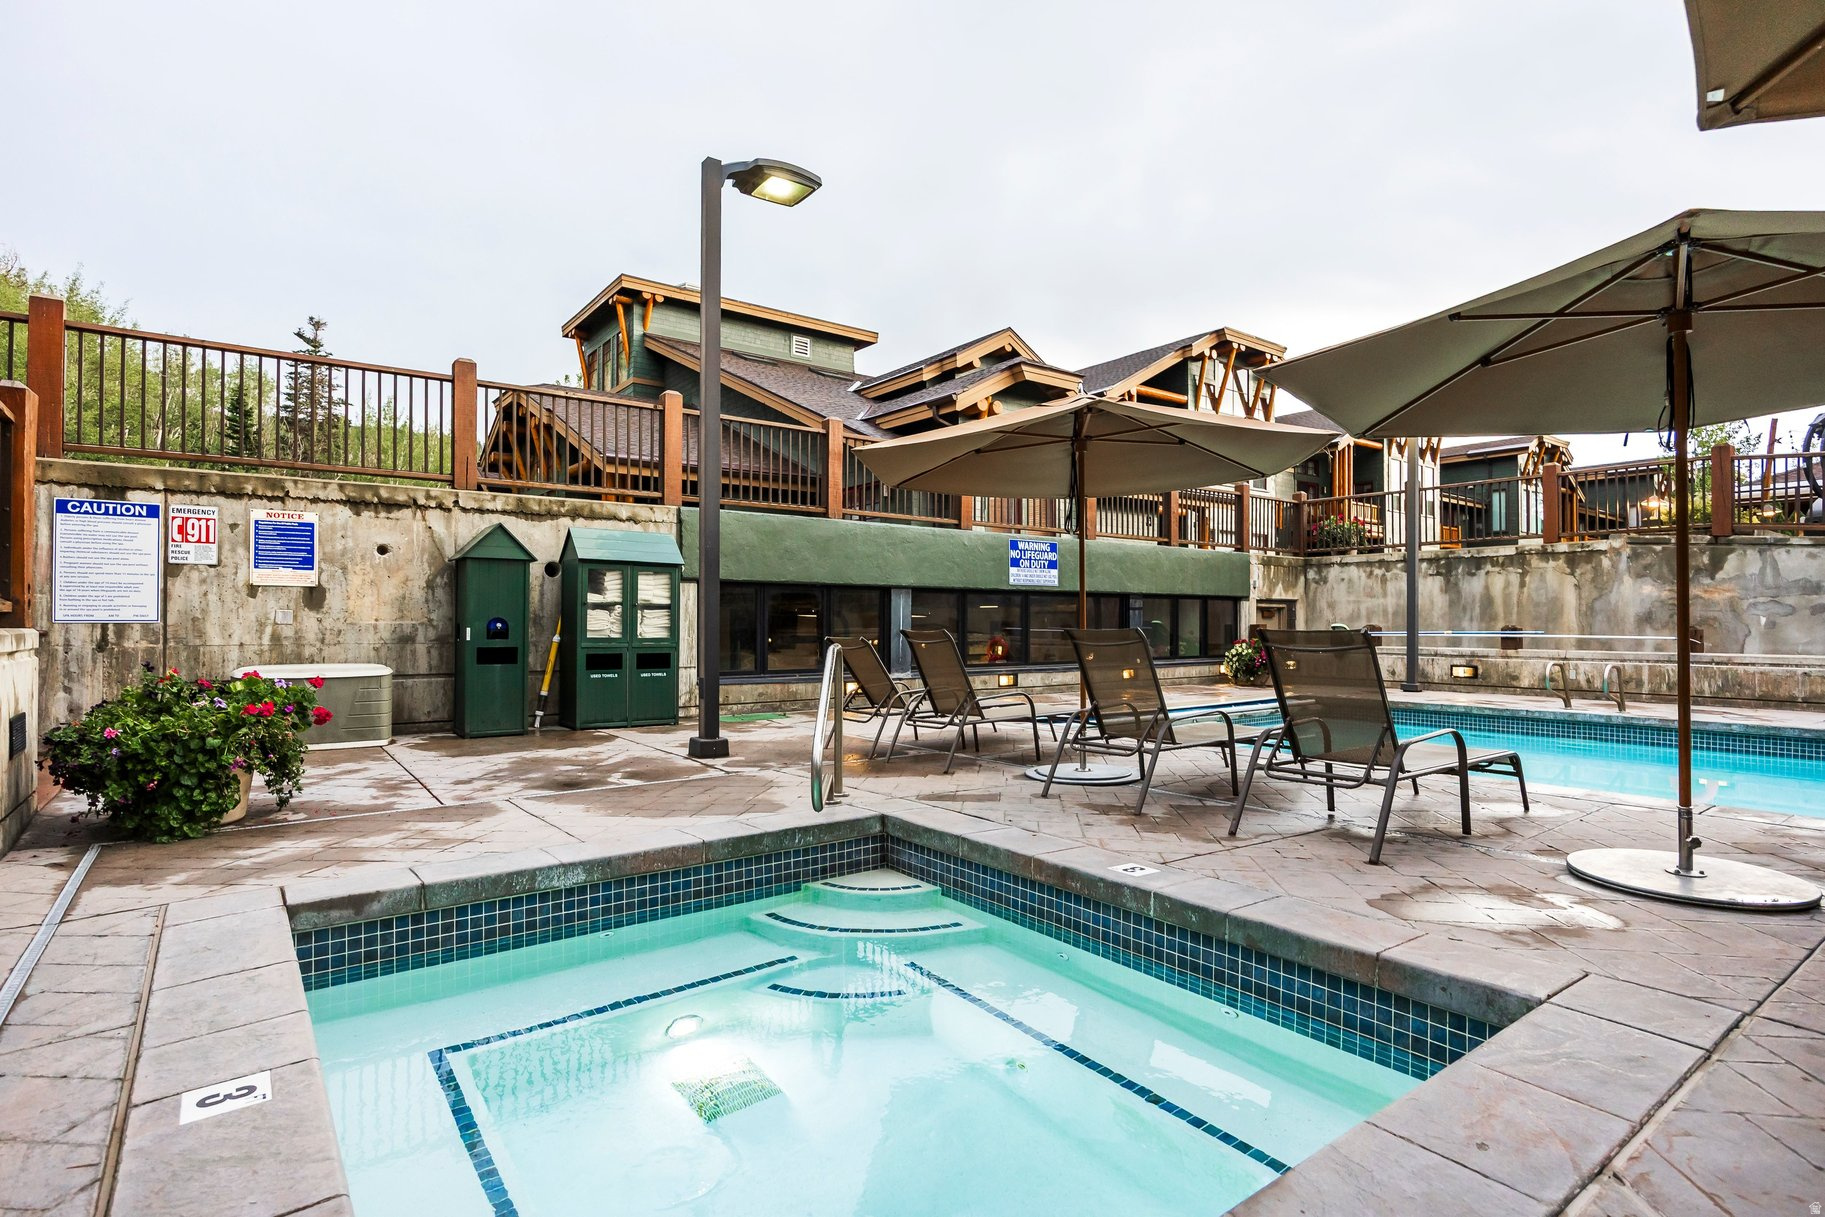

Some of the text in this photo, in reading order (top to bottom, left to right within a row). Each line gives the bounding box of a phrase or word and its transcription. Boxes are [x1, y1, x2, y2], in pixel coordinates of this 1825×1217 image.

[67, 501, 147, 516] CAUTION
[186, 518, 215, 542] 911
[1018, 541, 1051, 551] WARNING
[1010, 550, 1057, 560] NO LIFEGUARD
[1020, 559, 1049, 569] ON DUTY
[195, 1085, 258, 1108] 3
